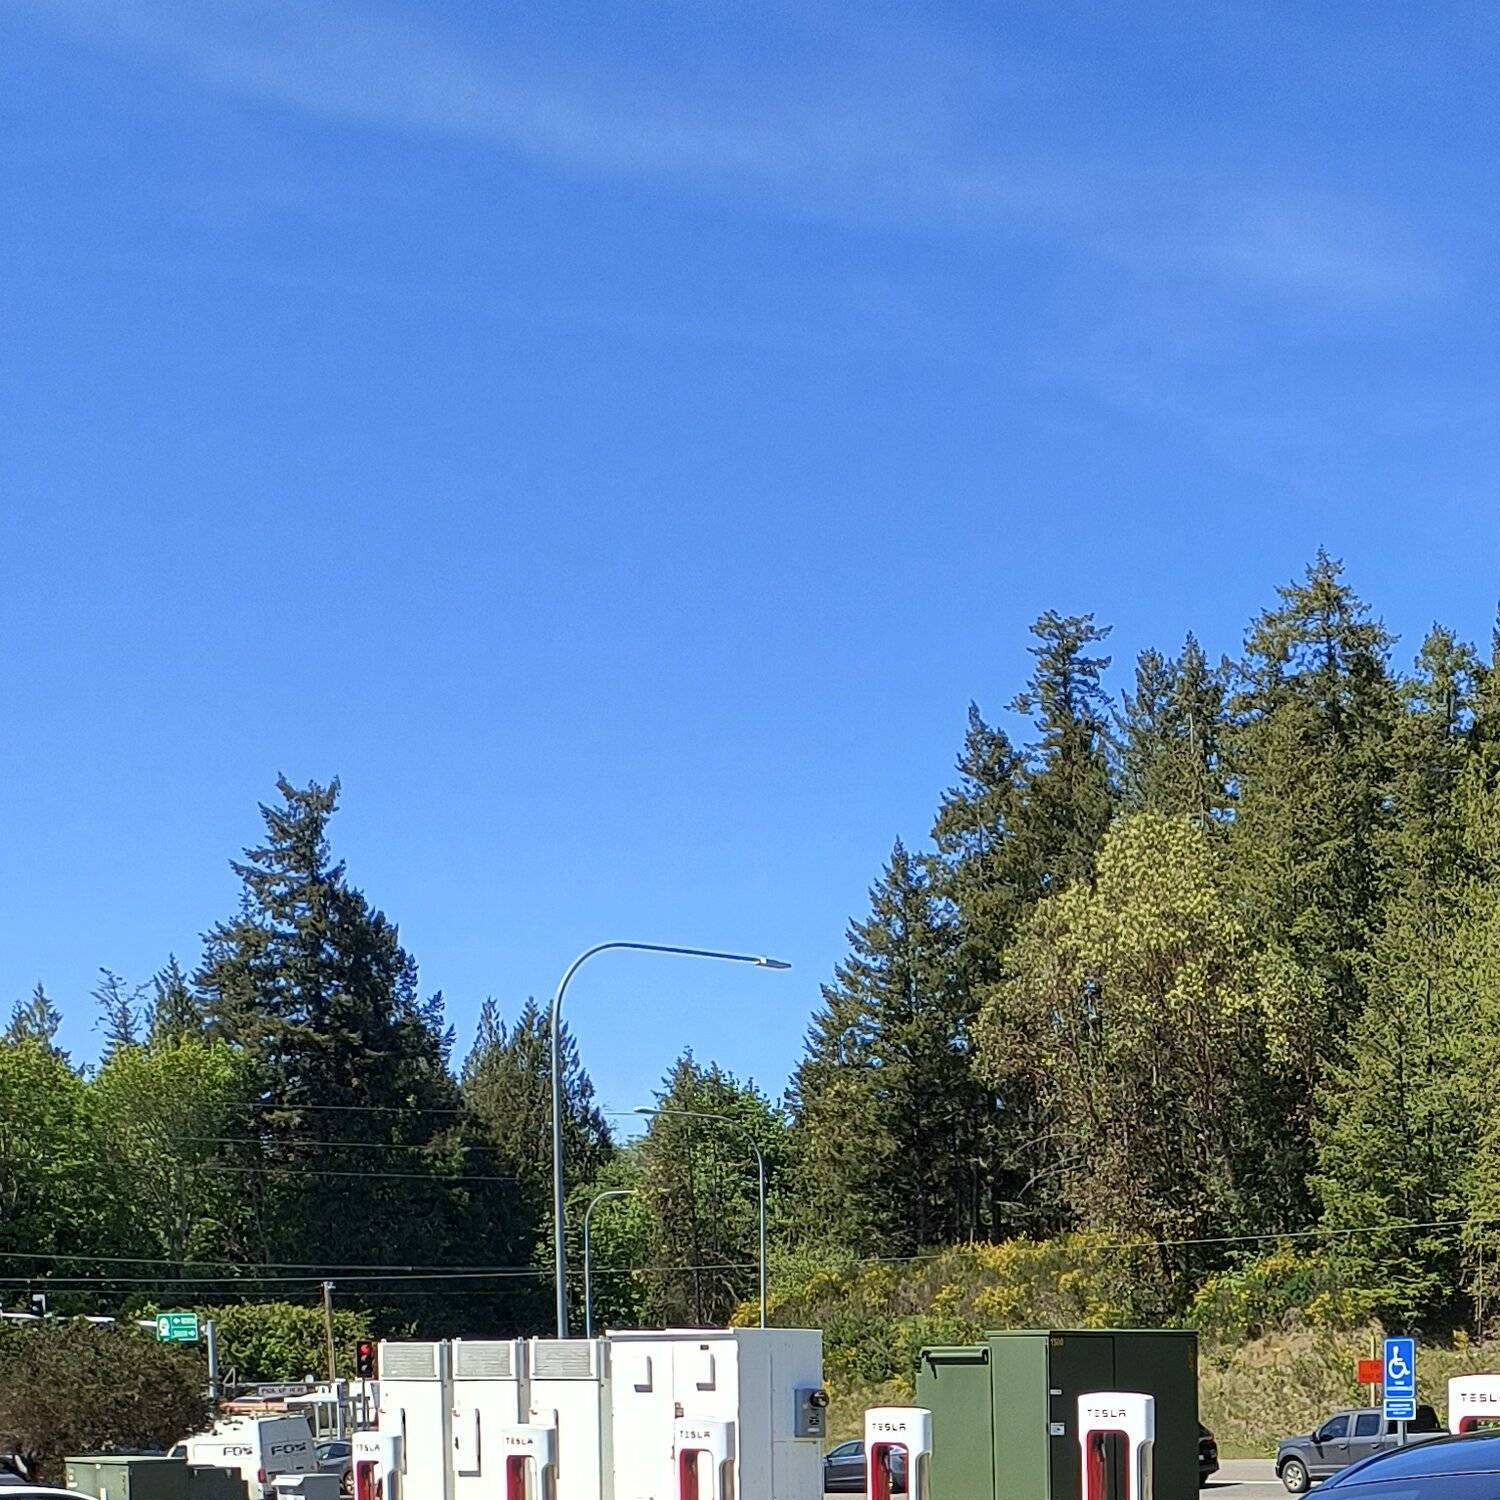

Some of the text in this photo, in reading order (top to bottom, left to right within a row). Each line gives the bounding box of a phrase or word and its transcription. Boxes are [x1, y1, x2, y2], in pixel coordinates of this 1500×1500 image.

[1087, 1409, 1126, 1418] TESLA
[872, 1423, 906, 1432] TESLA
[680, 1430, 711, 1439] TESLA
[506, 1437, 534, 1446] TESLA
